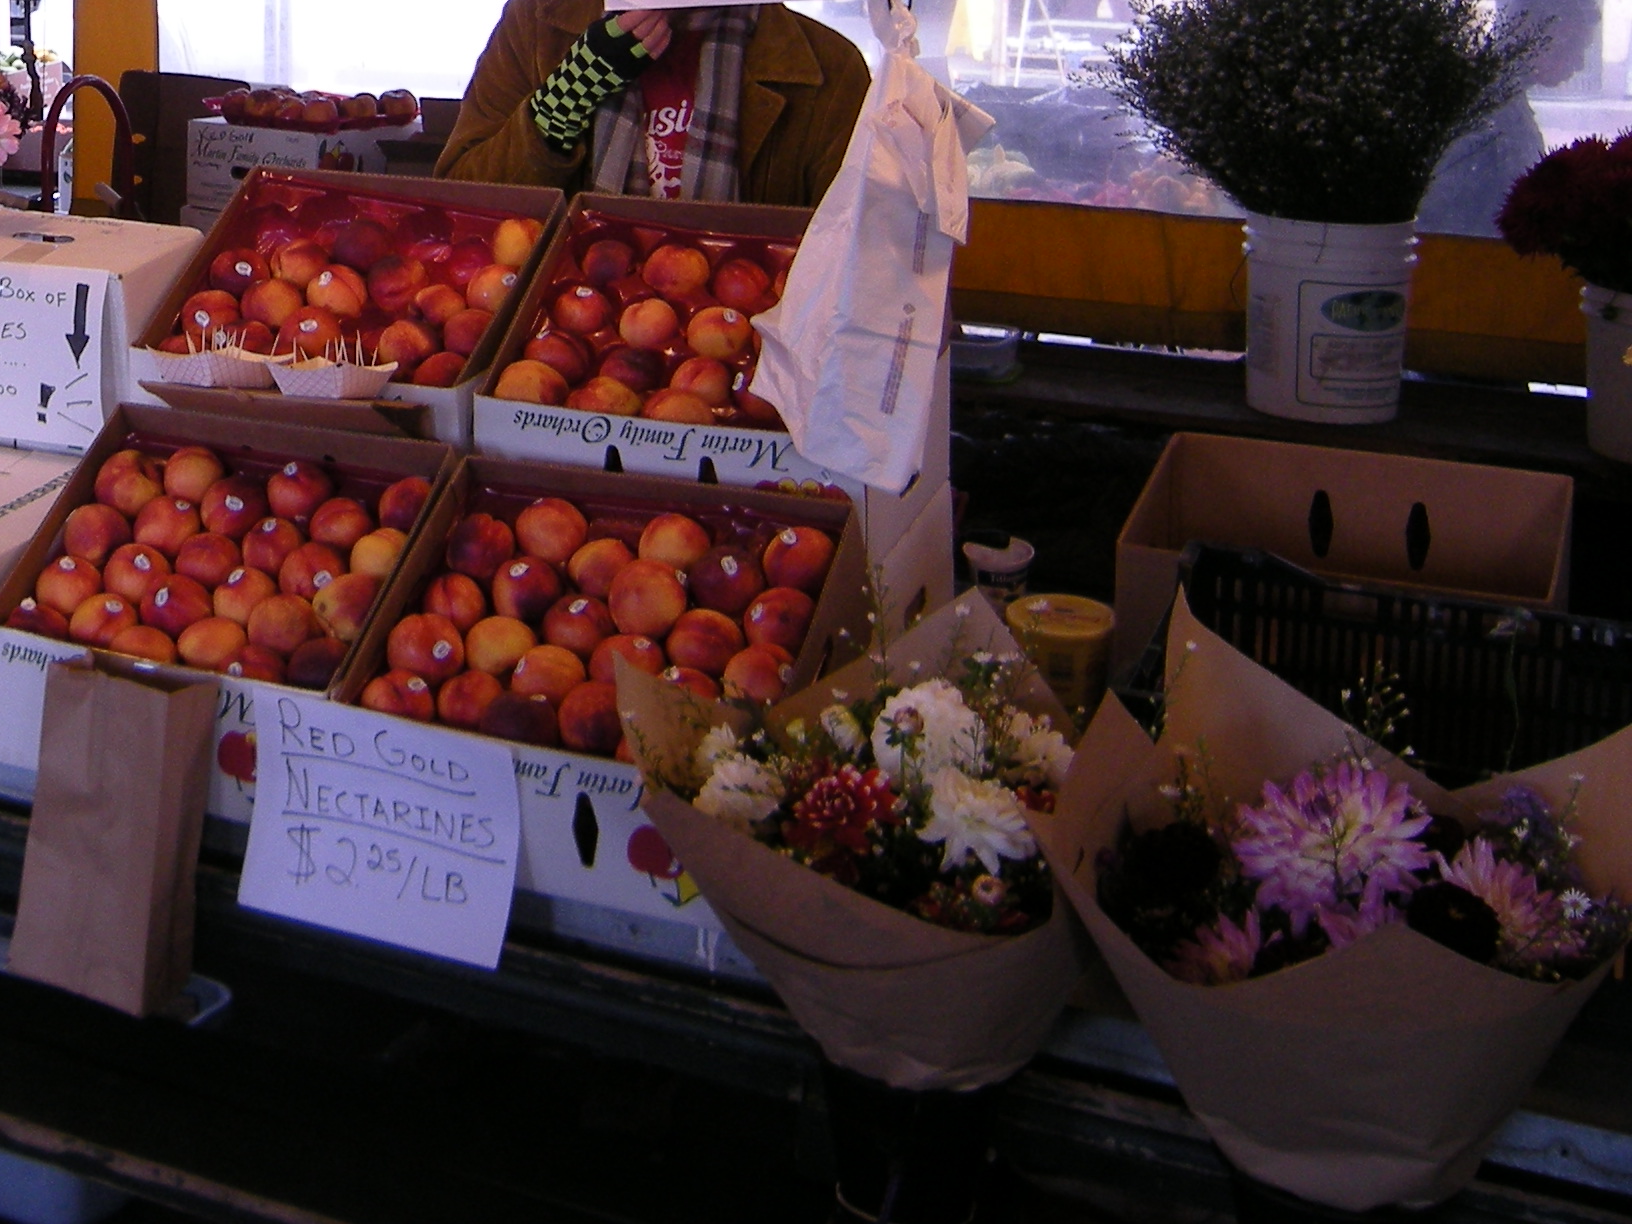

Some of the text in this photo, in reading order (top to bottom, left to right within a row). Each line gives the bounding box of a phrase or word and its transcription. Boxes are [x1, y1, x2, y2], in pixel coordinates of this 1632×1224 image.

[0, 277, 35, 302] BOX
[45, 291, 67, 307] OF
[513, 408, 793, 473] Martin Family Orchards
[277, 697, 355, 757] RED
[374, 728, 470, 784] GOLD
[285, 759, 496, 848] NECTARINES
